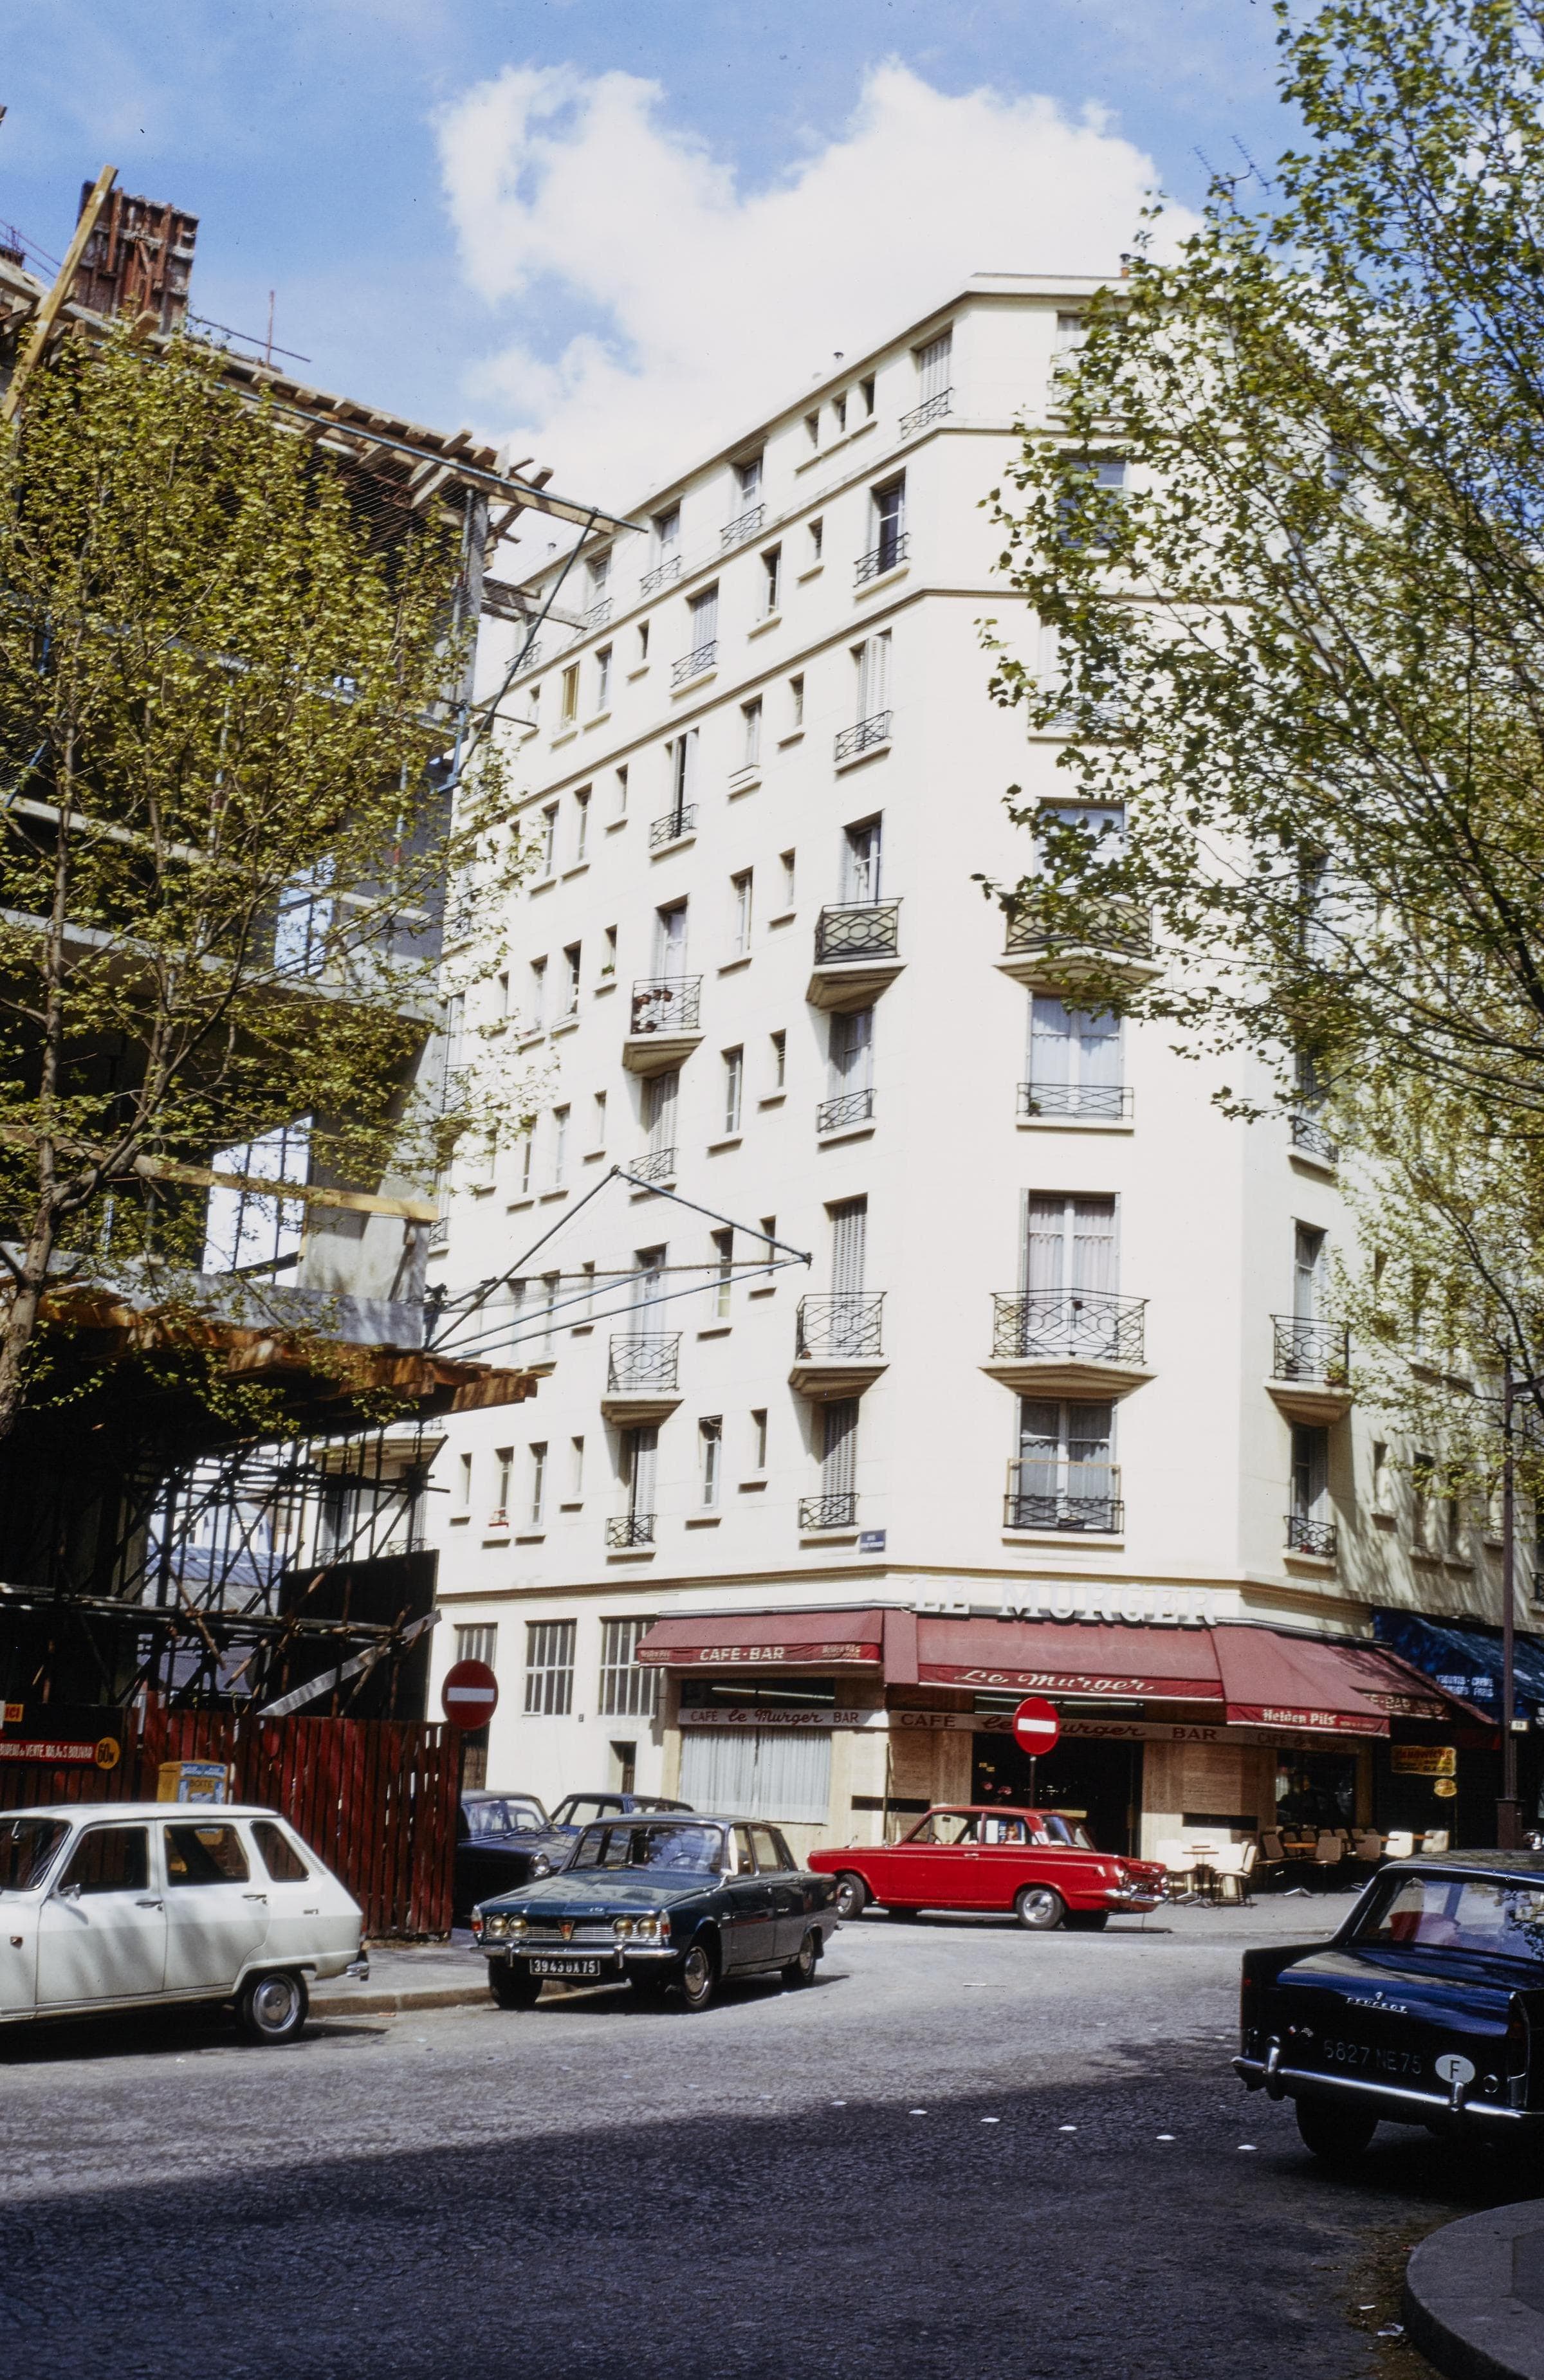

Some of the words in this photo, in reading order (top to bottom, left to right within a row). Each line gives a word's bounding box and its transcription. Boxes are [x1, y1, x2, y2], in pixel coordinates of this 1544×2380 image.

[914, 1575, 969, 1614] LE
[998, 1579, 1217, 1625] MURGER
[955, 1671, 1009, 1684] Le
[1018, 1673, 1154, 1692] Murger
[728, 1709, 747, 1723] le
[754, 1709, 823, 1726] Murger
[833, 1712, 859, 1724] BAR
[901, 1713, 956, 1728] CAFÉ
[982, 1716, 1015, 1730] le
[1059, 1723, 1146, 1737] urger
[1172, 1726, 1218, 1741] BAR
[1346, 1997, 1408, 2013] PEUGEOT
[1449, 2060, 1460, 2080] F
